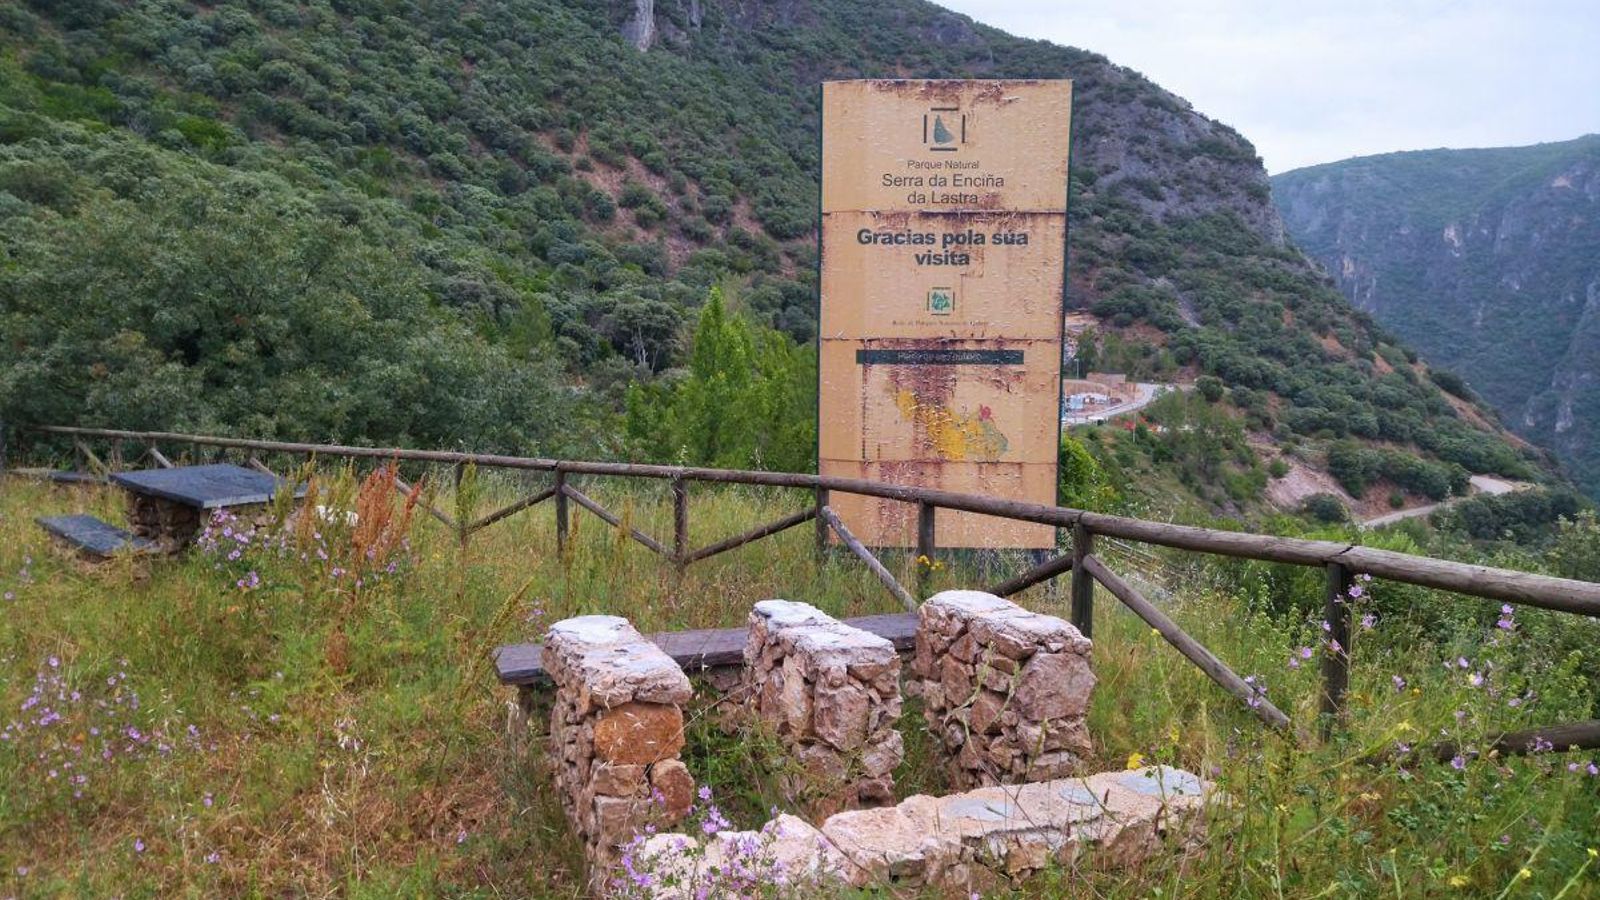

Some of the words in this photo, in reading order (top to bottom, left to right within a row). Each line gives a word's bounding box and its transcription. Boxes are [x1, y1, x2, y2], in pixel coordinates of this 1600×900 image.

[907, 160, 942, 170] Parque
[944, 160, 980, 169] Natural
[882, 173, 923, 187] Serra
[928, 173, 947, 187] da
[952, 173, 1005, 187] Enciña
[907, 191, 926, 204] da
[931, 191, 978, 204] Lastra
[857, 228, 936, 245] Gracias
[942, 229, 985, 248] pola
[914, 250, 970, 265] visita
